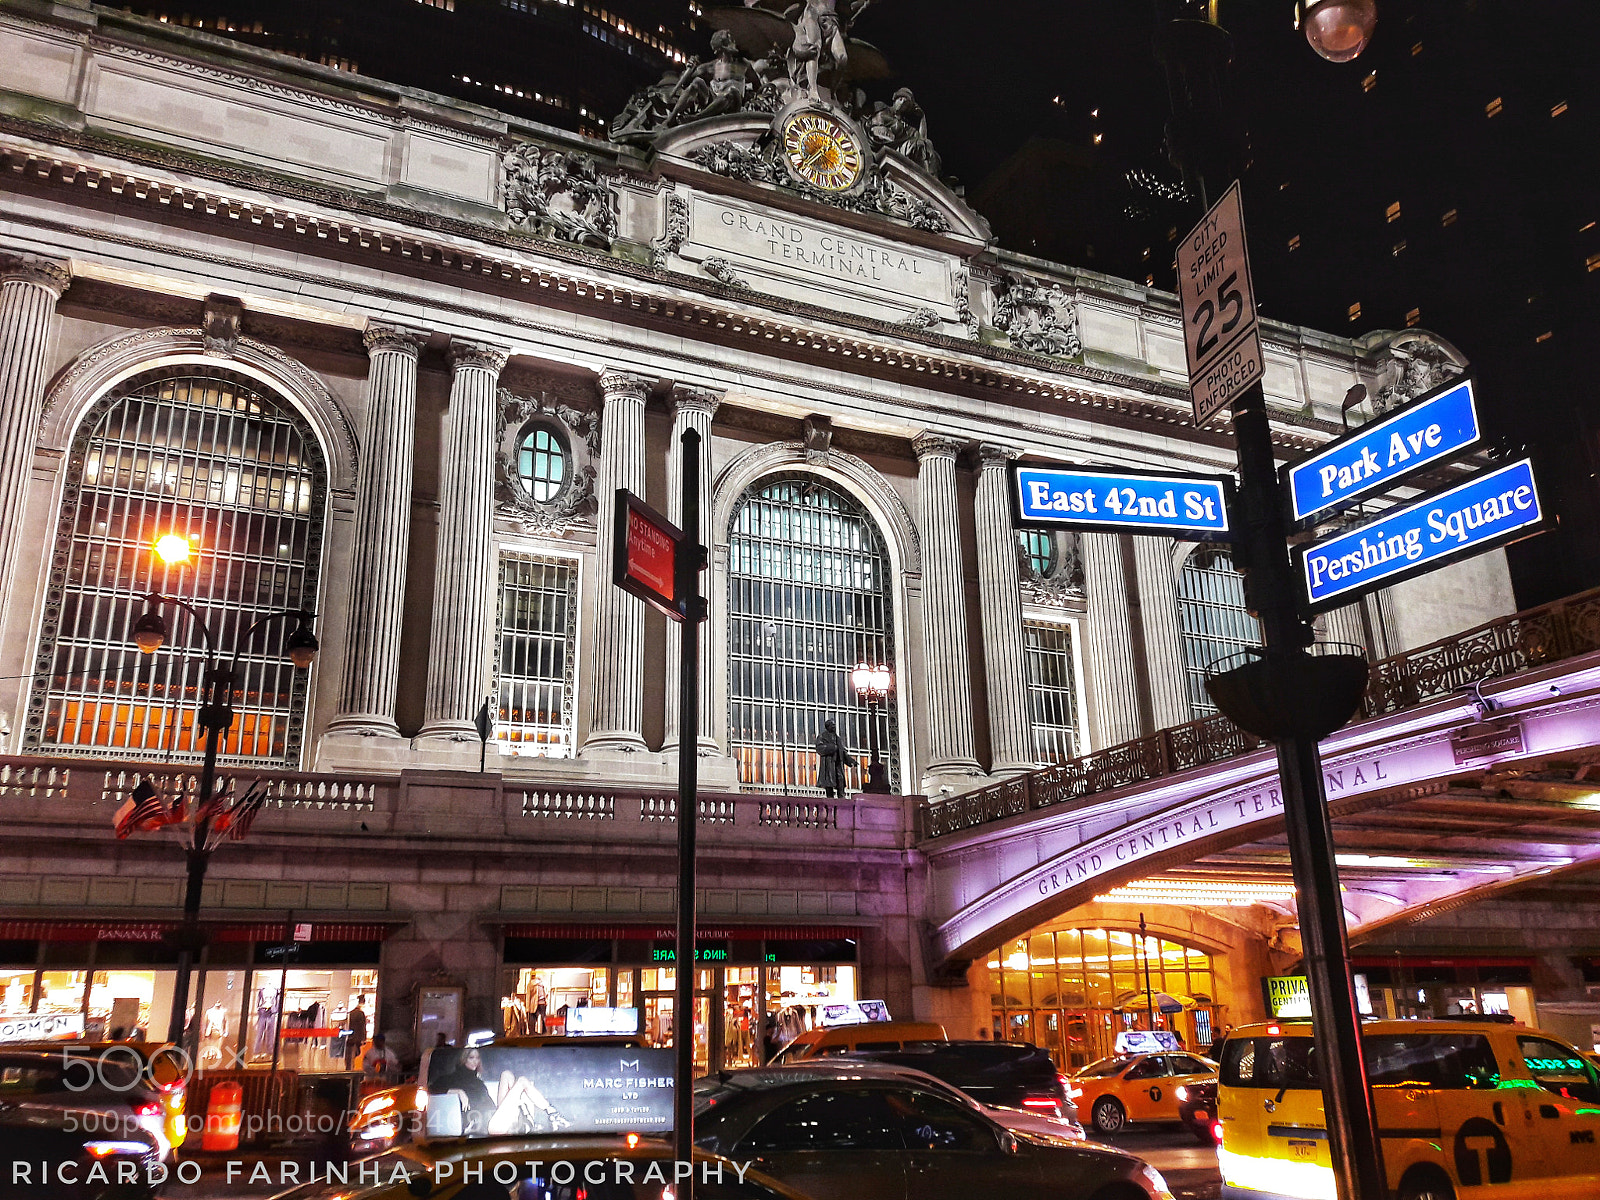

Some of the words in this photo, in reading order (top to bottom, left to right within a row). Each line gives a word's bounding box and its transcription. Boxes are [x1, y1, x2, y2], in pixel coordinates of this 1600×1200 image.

[721, 211, 803, 243] GRAND
[820, 236, 922, 275] CENTRAL
[1193, 213, 1219, 252] CITY
[767, 239, 881, 281] TERMINAL
[1190, 231, 1228, 279] SPEED
[1196, 255, 1226, 297] LIMIT
[1191, 270, 1243, 362] 25
[1199, 359, 1256, 416] ENFORCED
[1207, 351, 1242, 391] PHOTO
[1320, 446, 1382, 498] Park
[1386, 423, 1442, 473] Ave
[1027, 480, 1097, 514] East
[1103, 486, 1178, 519] 42nd
[1184, 490, 1218, 522] St
[639, 521, 670, 552] STANDING
[1309, 528, 1423, 588] Pershing
[1429, 481, 1534, 551] Square
[1037, 854, 1103, 895] GRAND
[1115, 809, 1219, 861] CENTRAL
[1234, 760, 1388, 818] TERNAL
[98, 930, 147, 940] BANANA
[695, 930, 734, 939] REPUBLIC
[1270, 979, 1308, 996] PRIVA
[583, 1077, 623, 1088] MARC
[626, 1077, 675, 1088] FISHER
